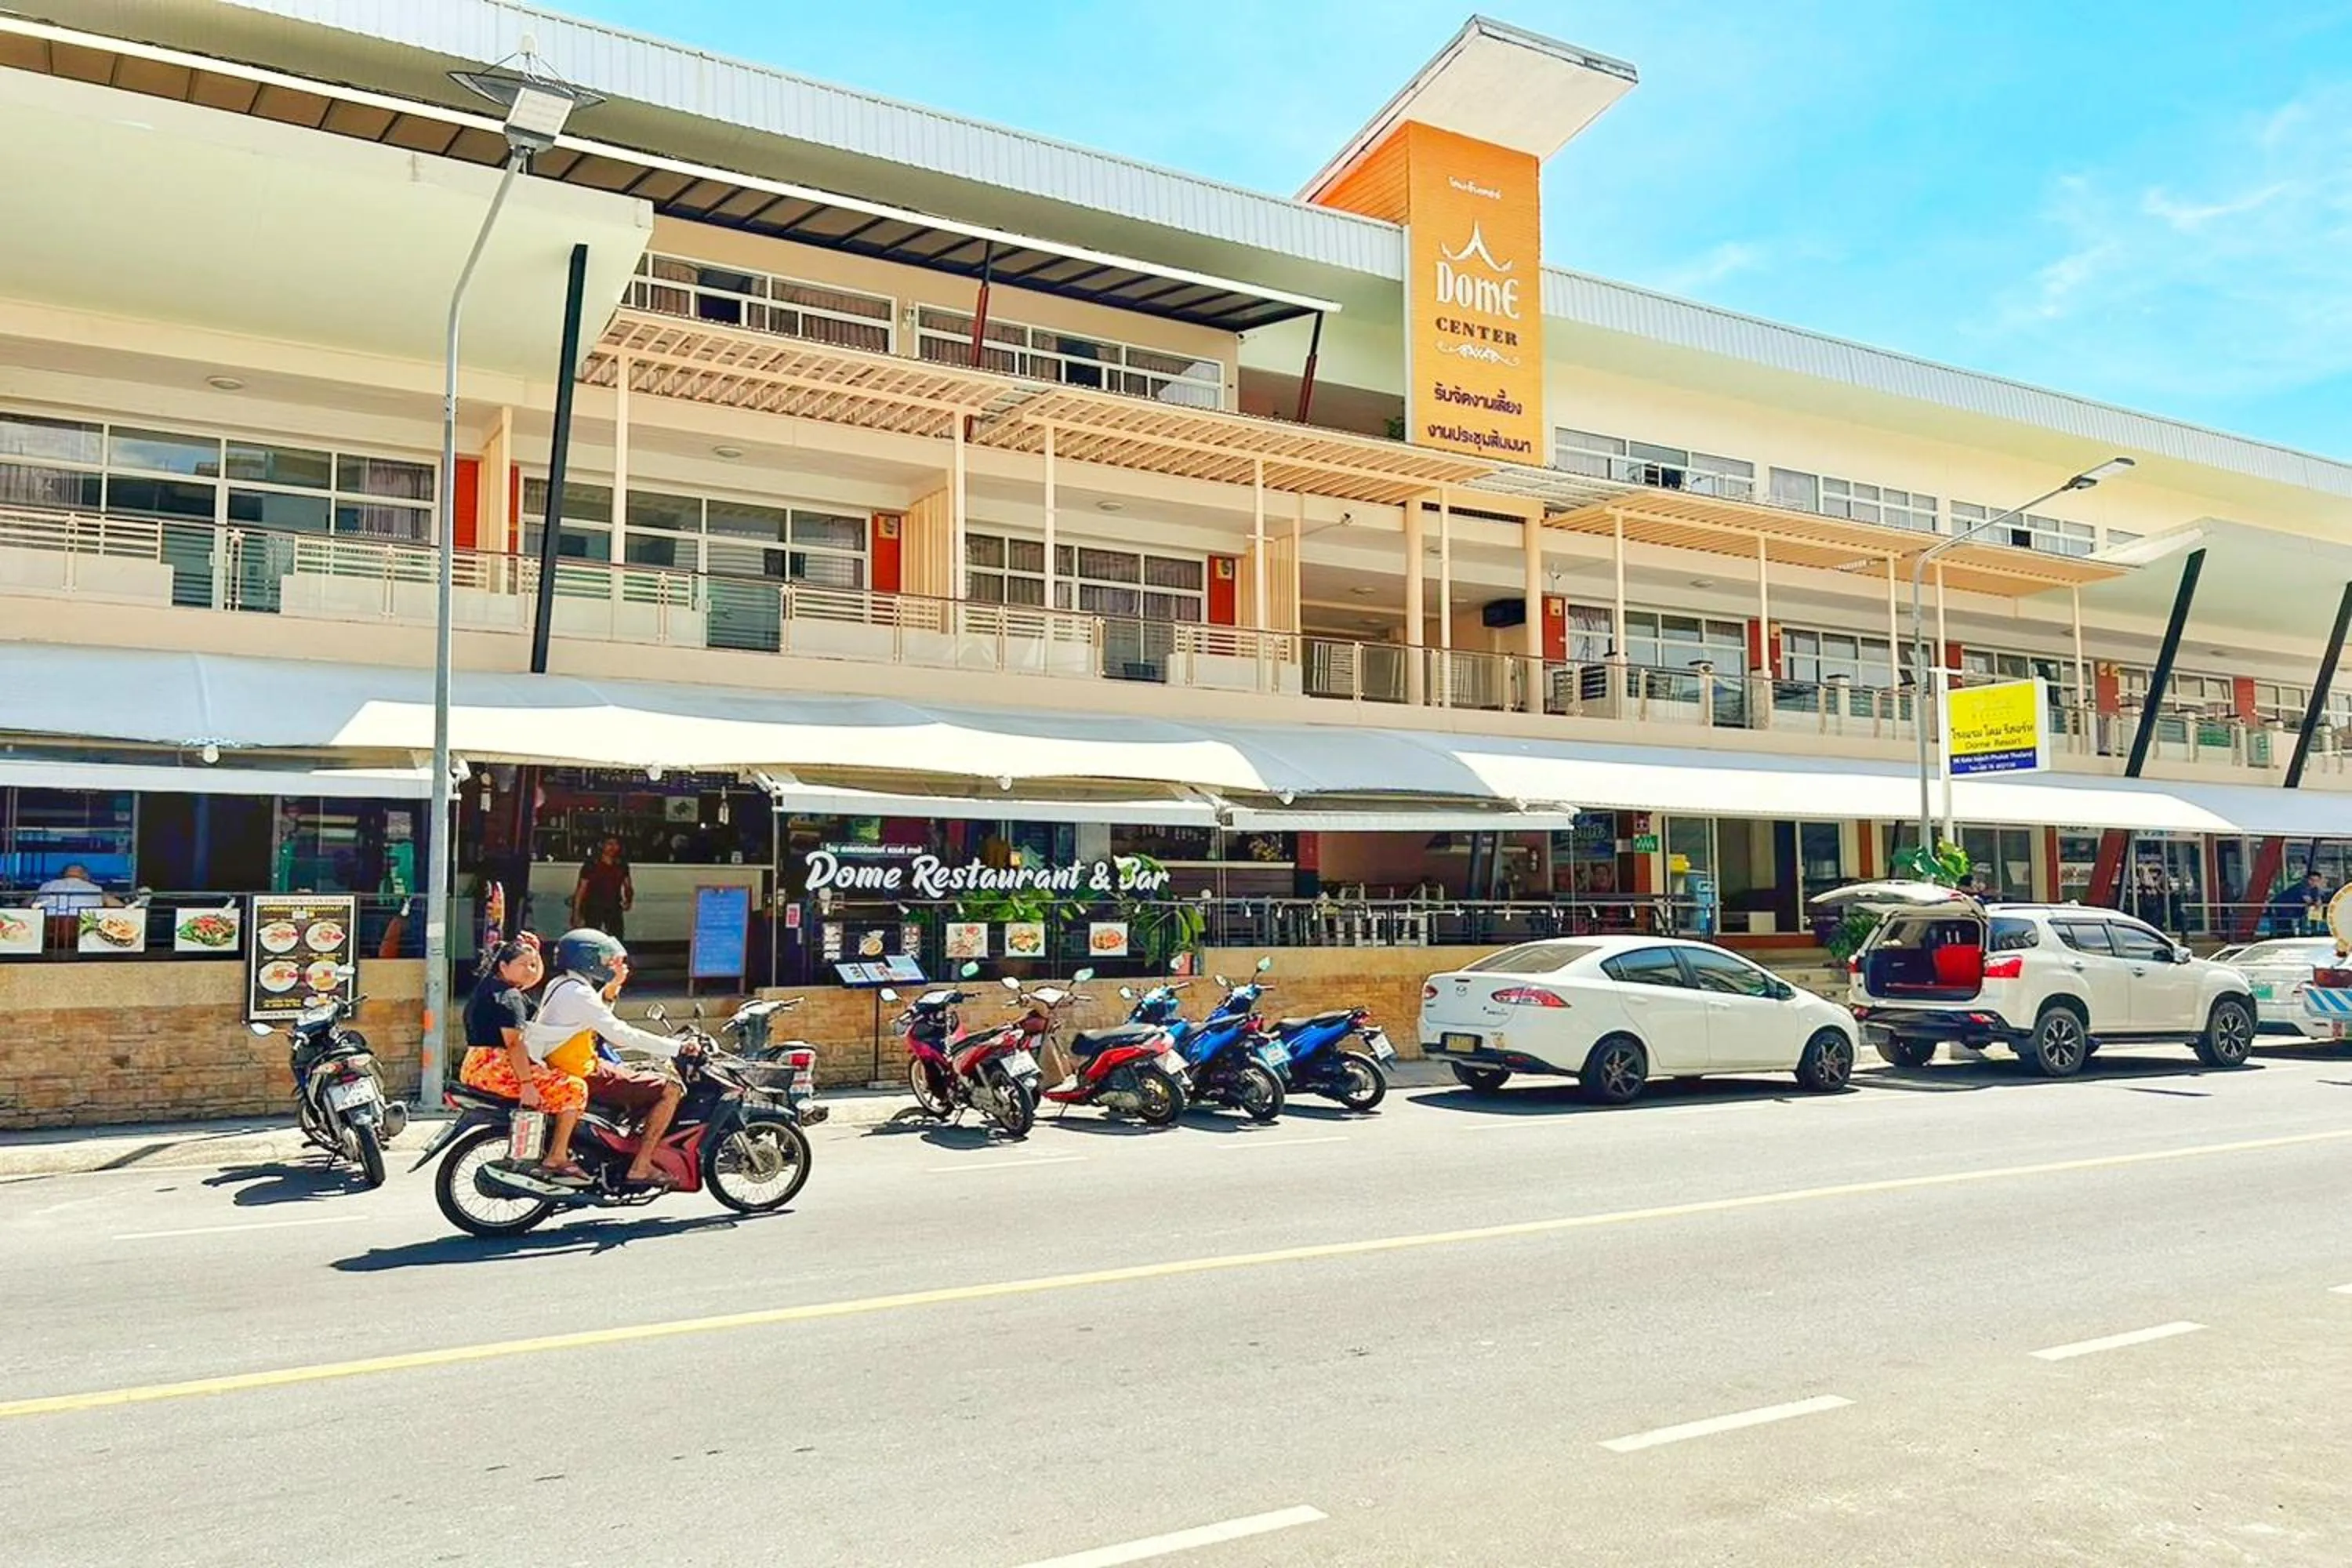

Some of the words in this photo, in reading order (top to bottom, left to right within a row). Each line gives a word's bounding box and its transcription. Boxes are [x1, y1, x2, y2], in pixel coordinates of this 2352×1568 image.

[1436, 316, 1519, 347] CENTER
[1965, 740, 1991, 750] Dome
[805, 851, 902, 891] Dome
[911, 855, 1086, 898] Restaurant
[1089, 861, 1112, 891] &
[1113, 855, 1171, 891] Bar
